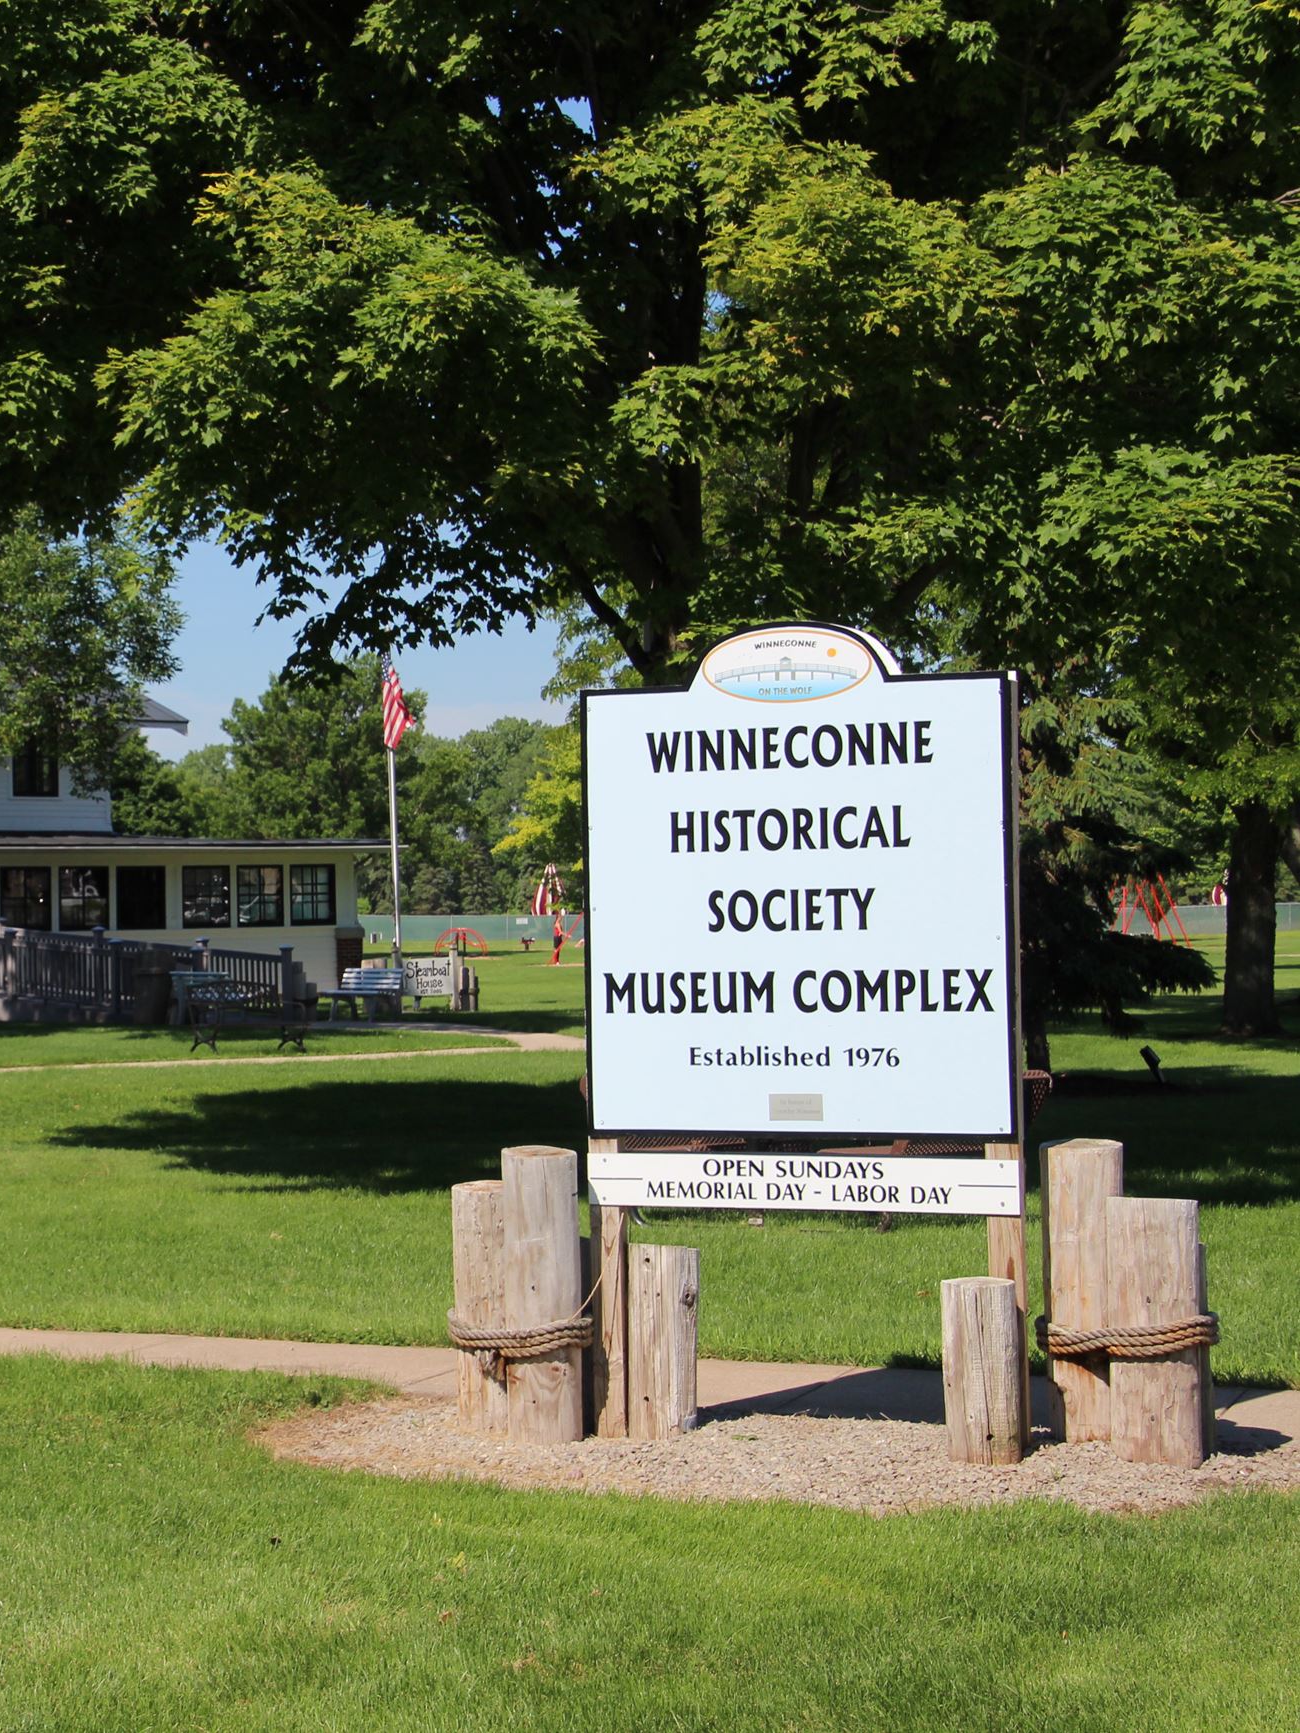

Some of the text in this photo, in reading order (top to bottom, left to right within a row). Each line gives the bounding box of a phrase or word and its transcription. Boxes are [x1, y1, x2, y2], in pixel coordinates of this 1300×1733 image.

[754, 639, 817, 650] WINNECONNE
[758, 686, 813, 696] ON THE WOLF
[646, 720, 933, 773] WINNECONNE
[670, 805, 911, 853] HISTORICAL
[708, 888, 875, 933] SOCIETY
[406, 960, 451, 979] Steamboat
[416, 978, 443, 989] House
[604, 969, 995, 1014] MUSEUM COMPLEX
[689, 1045, 900, 1068] Established 1976
[702, 1158, 885, 1180] OPEN SUNDAYS
[647, 1181, 758, 1201] MEMORIAL
[766, 1183, 807, 1202] DAY
[831, 1184, 901, 1204] LABOR
[910, 1186, 952, 1206] DAY
